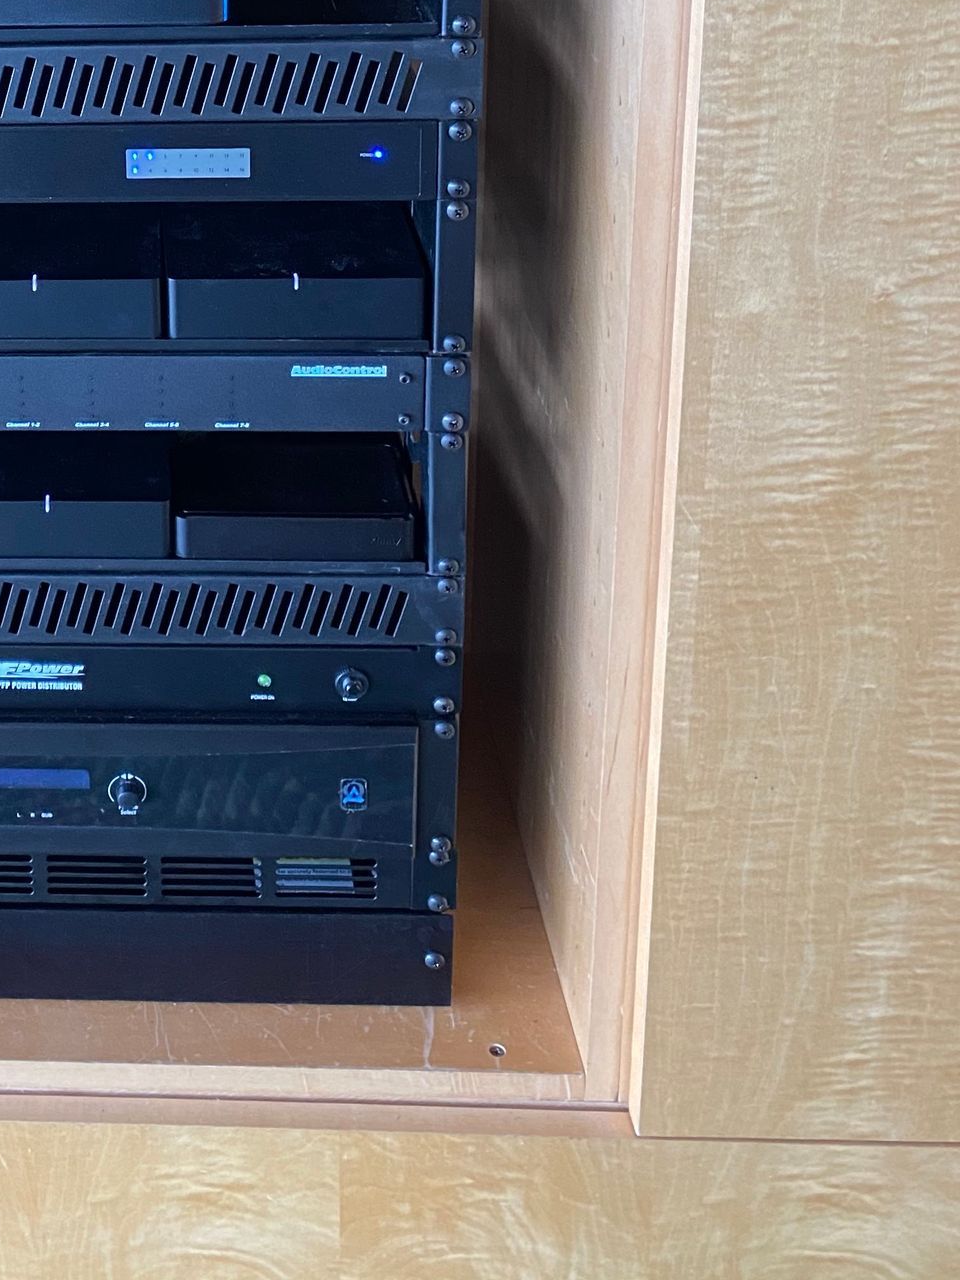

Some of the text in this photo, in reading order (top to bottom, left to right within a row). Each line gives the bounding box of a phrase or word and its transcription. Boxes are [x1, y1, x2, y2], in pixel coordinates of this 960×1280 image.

[290, 365, 388, 377] AudioControl
[11, 681, 37, 690] POWER
[37, 681, 83, 691] DISTRIBUTOR
